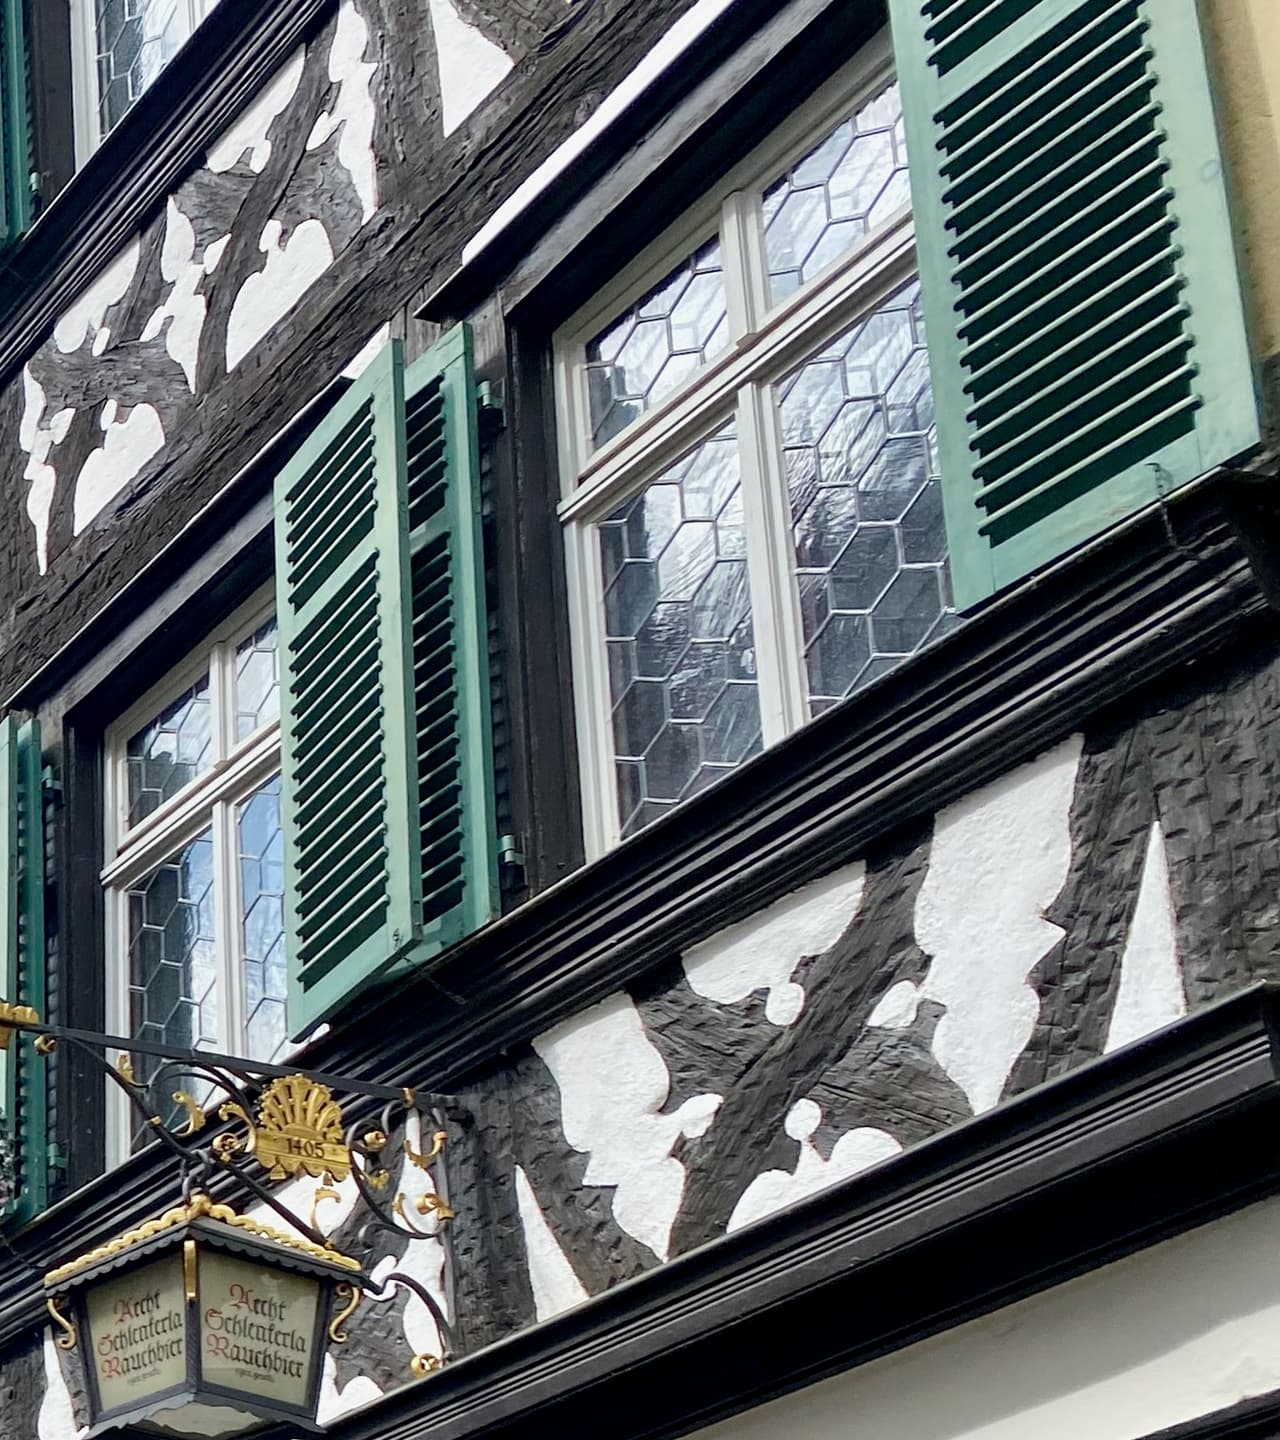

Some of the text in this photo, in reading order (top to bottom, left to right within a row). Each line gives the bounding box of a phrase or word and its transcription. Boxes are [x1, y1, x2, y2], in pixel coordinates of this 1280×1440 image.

[229, 1283, 287, 1321] Aecht
[204, 1308, 306, 1352] Schlenkerla
[100, 1338, 183, 1378] Rauchbier
[206, 1334, 304, 1378] Rauchbier
